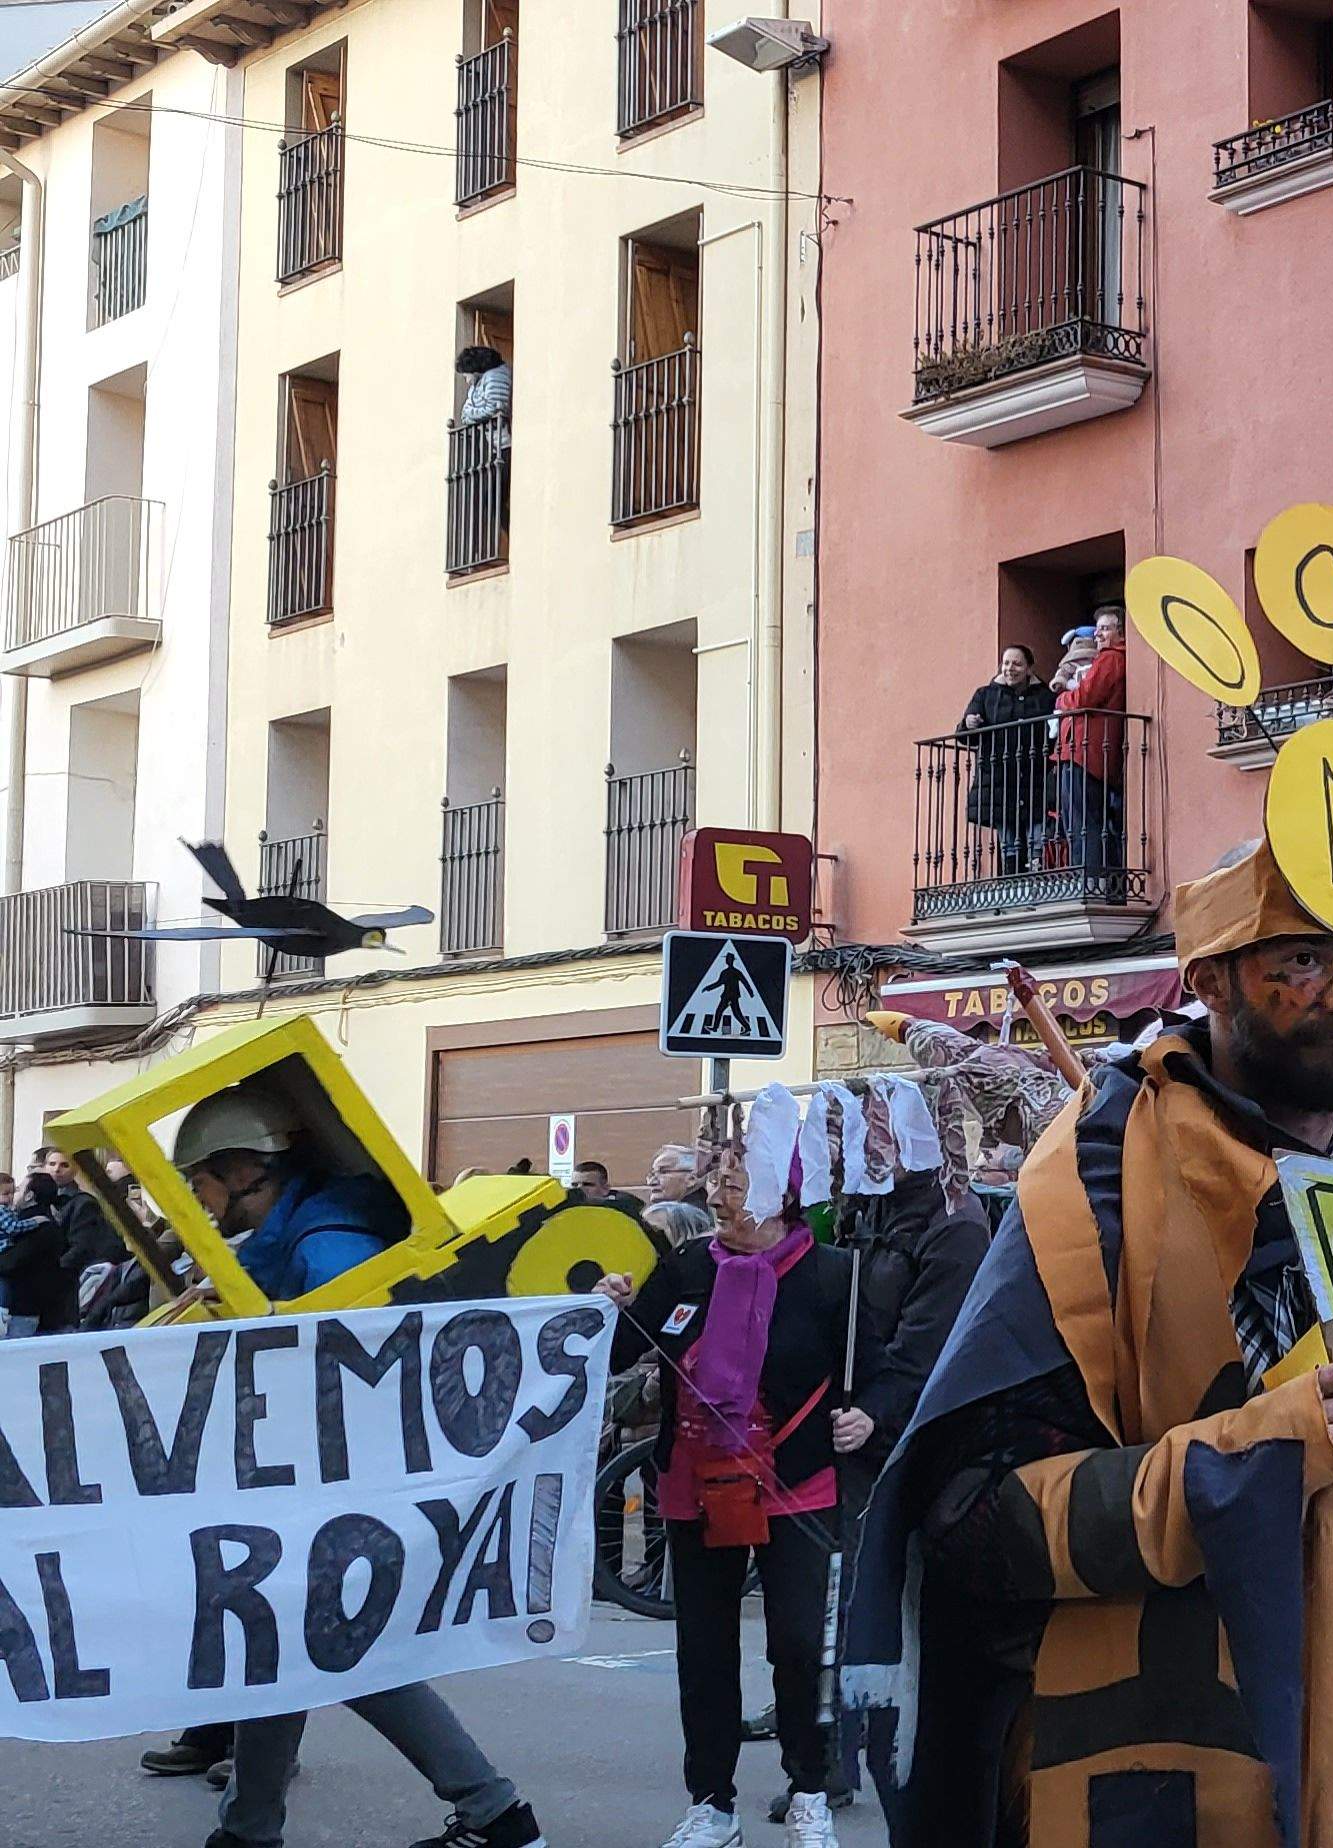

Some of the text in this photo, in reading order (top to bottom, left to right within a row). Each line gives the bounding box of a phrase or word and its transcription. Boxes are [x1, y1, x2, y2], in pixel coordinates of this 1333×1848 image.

[703, 911, 799, 931] TABACOS
[945, 978, 1109, 1018] TABCOS
[187, 1474, 563, 1691] ROYA!
